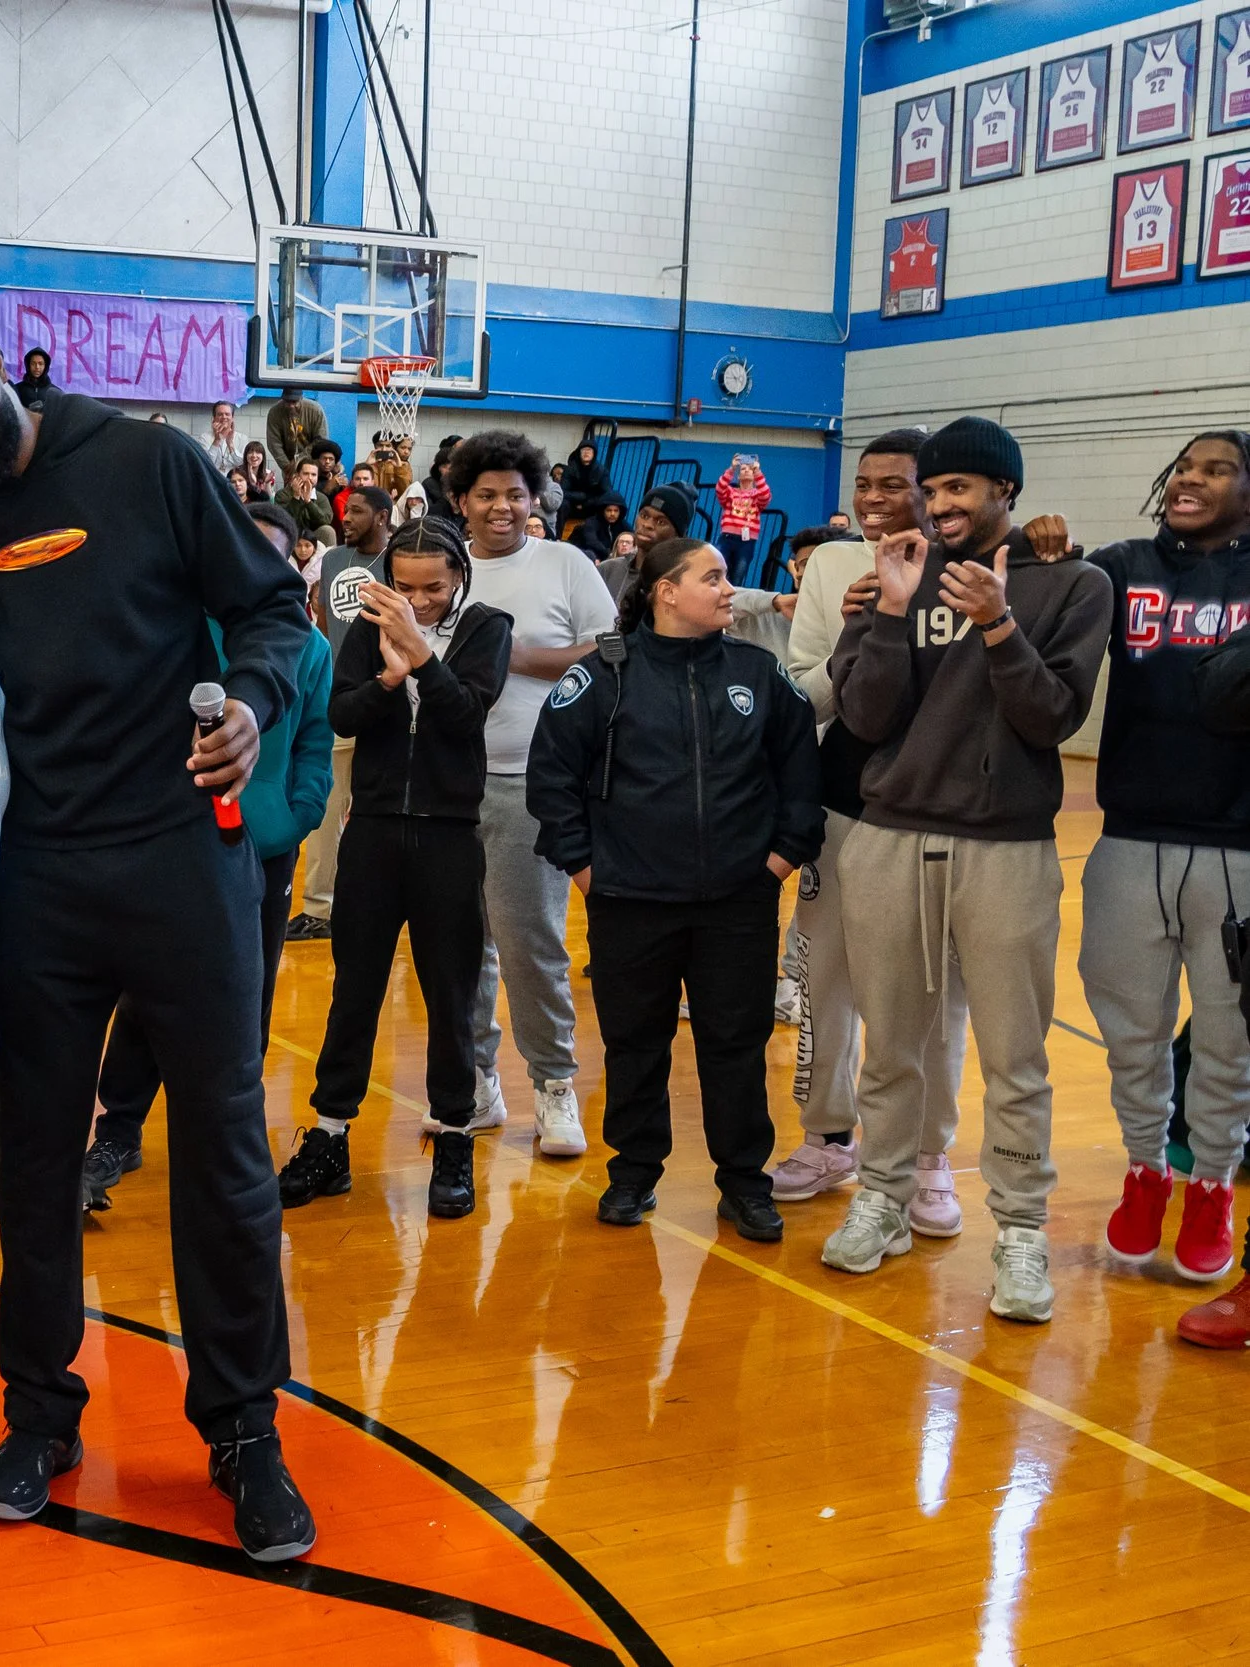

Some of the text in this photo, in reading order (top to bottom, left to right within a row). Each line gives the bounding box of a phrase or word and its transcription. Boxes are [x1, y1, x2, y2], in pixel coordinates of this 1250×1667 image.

[1150, 79, 1165, 94] 22
[987, 123, 998, 136] 12
[916, 138, 927, 150] 34
[1229, 196, 1250, 217] 22
[1137, 220, 1157, 241] 13
[16, 303, 230, 393] DREAM
[993, 1145, 1041, 1161] ESSENTIALS
